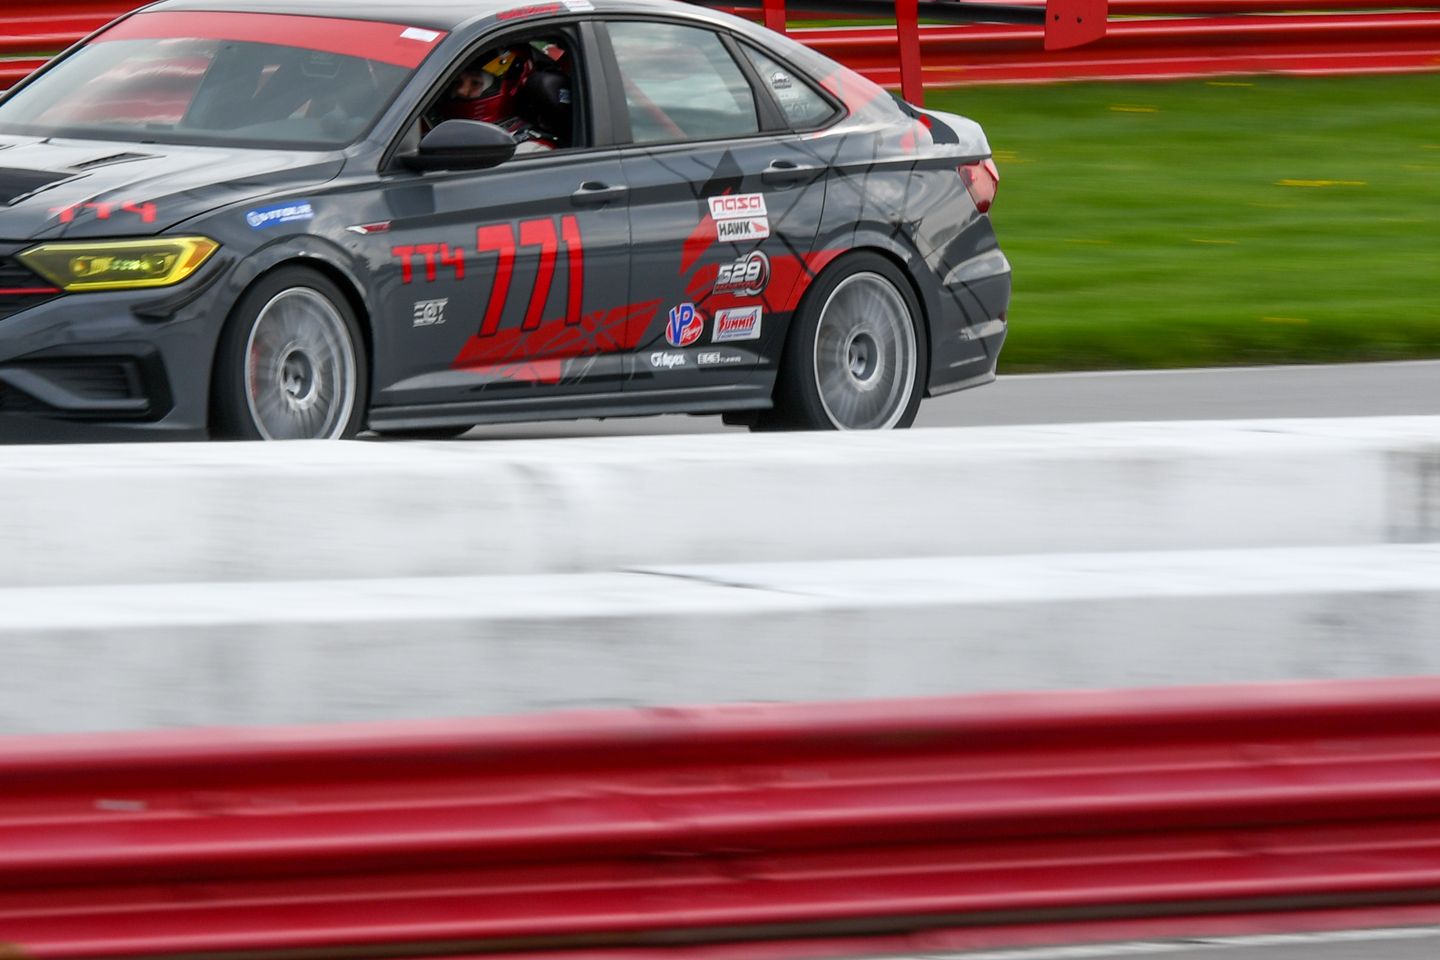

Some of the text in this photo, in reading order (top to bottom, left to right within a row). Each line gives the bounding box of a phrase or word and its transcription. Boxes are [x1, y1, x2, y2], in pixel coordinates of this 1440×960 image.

[713, 196, 761, 211] nasa
[719, 221, 751, 236] HAWK
[391, 213, 585, 338] TT4 771
[669, 303, 696, 345] VP
